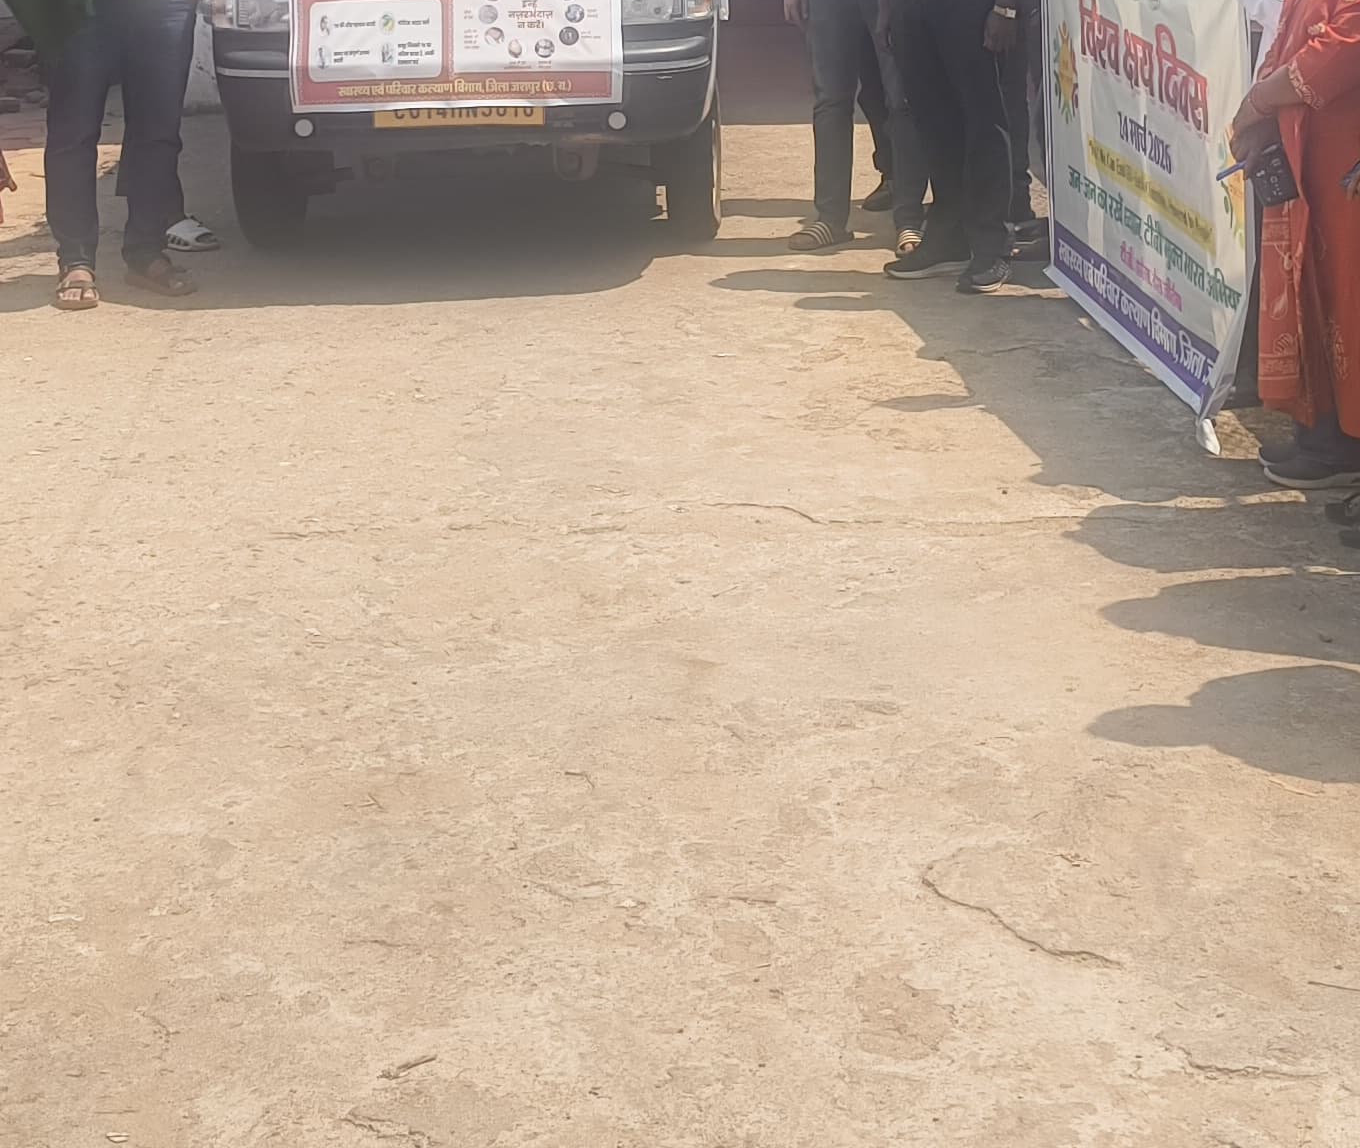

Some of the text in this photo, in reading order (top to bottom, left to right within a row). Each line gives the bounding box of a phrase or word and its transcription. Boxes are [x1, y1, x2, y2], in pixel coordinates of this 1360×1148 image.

[1122, 28, 1155, 98] क्षय
[1154, 22, 1209, 135] दिवस
[1128, 113, 1147, 156] मार्च
[1057, 238, 1083, 280] स्वास्थ्य
[1082, 259, 1094, 289] एवं
[1093, 262, 1121, 310] परिवार
[1120, 291, 1151, 337] कल्याण
[1178, 329, 1206, 381] जिला
